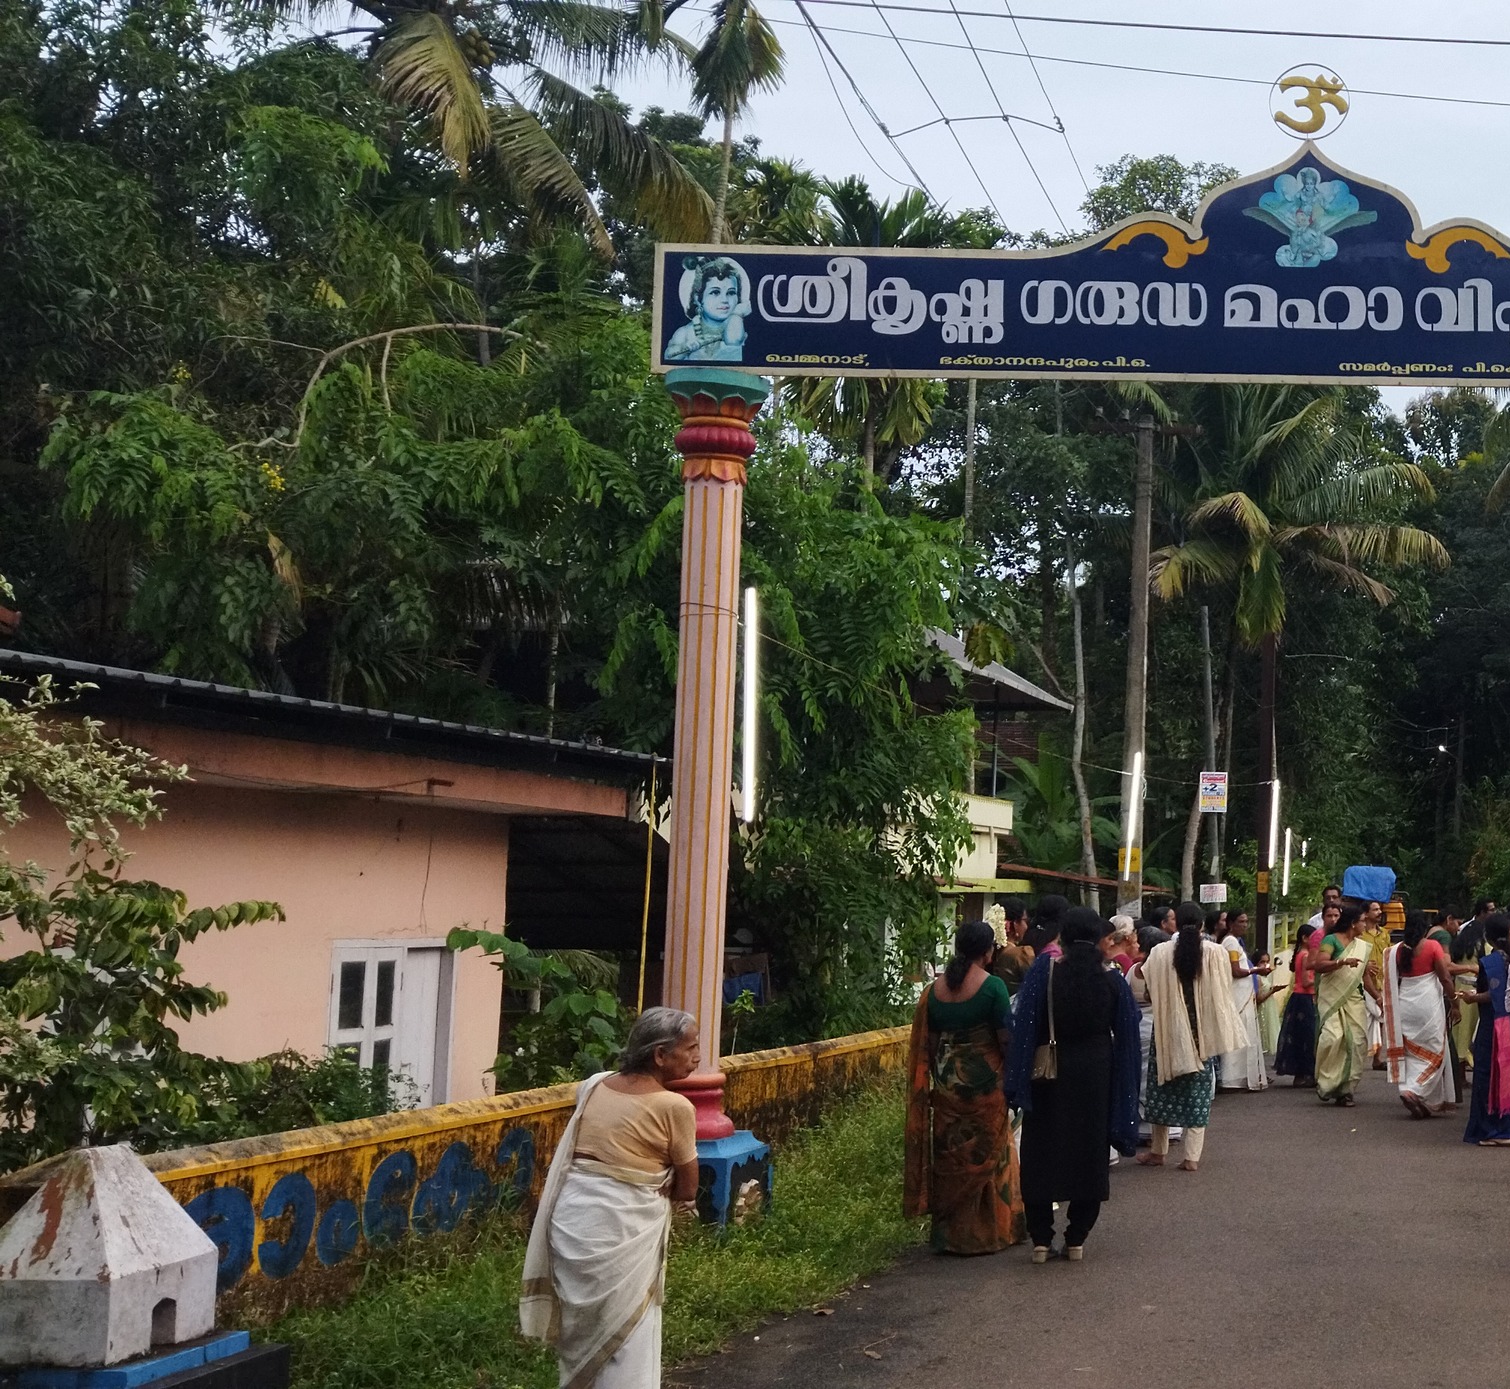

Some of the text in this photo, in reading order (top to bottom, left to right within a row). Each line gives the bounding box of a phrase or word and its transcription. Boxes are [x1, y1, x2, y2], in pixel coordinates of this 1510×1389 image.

[757, 255, 1005, 345] ശ്രീകൃഷ്ണ
[1020, 279, 1208, 328] ഗരുഡ
[1223, 283, 1404, 331] മഹാ
